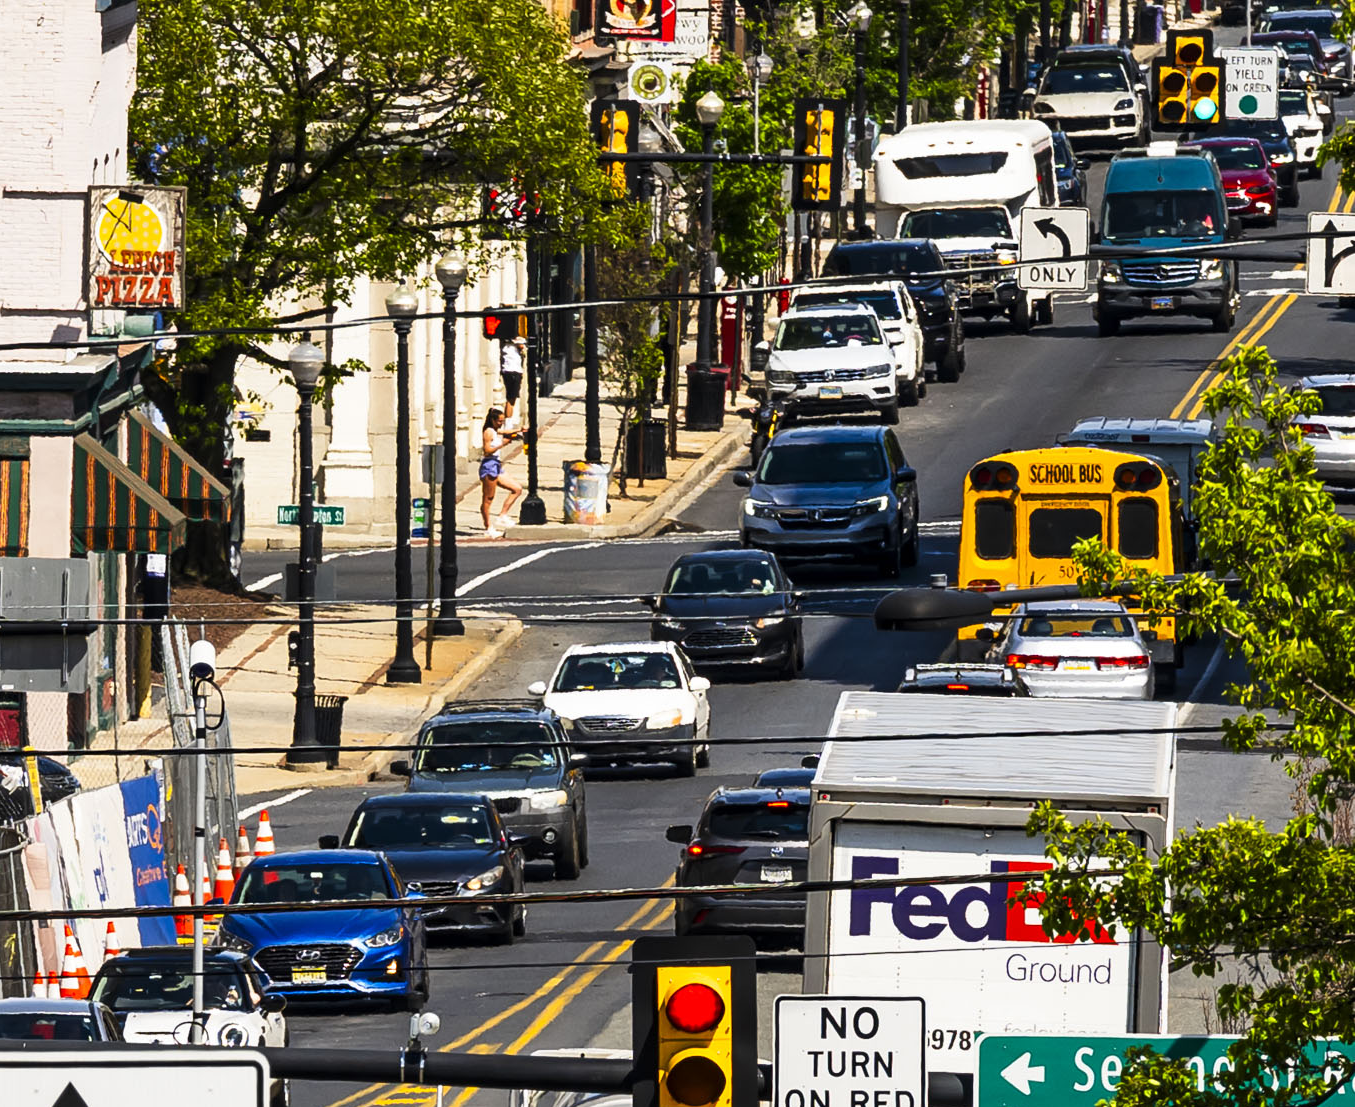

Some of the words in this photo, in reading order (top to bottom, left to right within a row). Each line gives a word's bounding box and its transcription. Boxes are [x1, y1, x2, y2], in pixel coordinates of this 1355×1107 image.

[1225, 56, 1245, 65] LEFT
[1250, 56, 1273, 65] TURN
[1235, 69, 1264, 80] YIELD
[1226, 83, 1238, 92] ON
[1243, 83, 1272, 92] GREEN
[1029, 266, 1076, 282] ONLY
[95, 276, 175, 305] PIZZA
[1030, 464, 1076, 483] SCHOOL
[1079, 464, 1102, 483] BUS
[1005, 953, 1112, 985] Ground
[820, 1006, 880, 1040] NO
[807, 1051, 893, 1078] TURN
